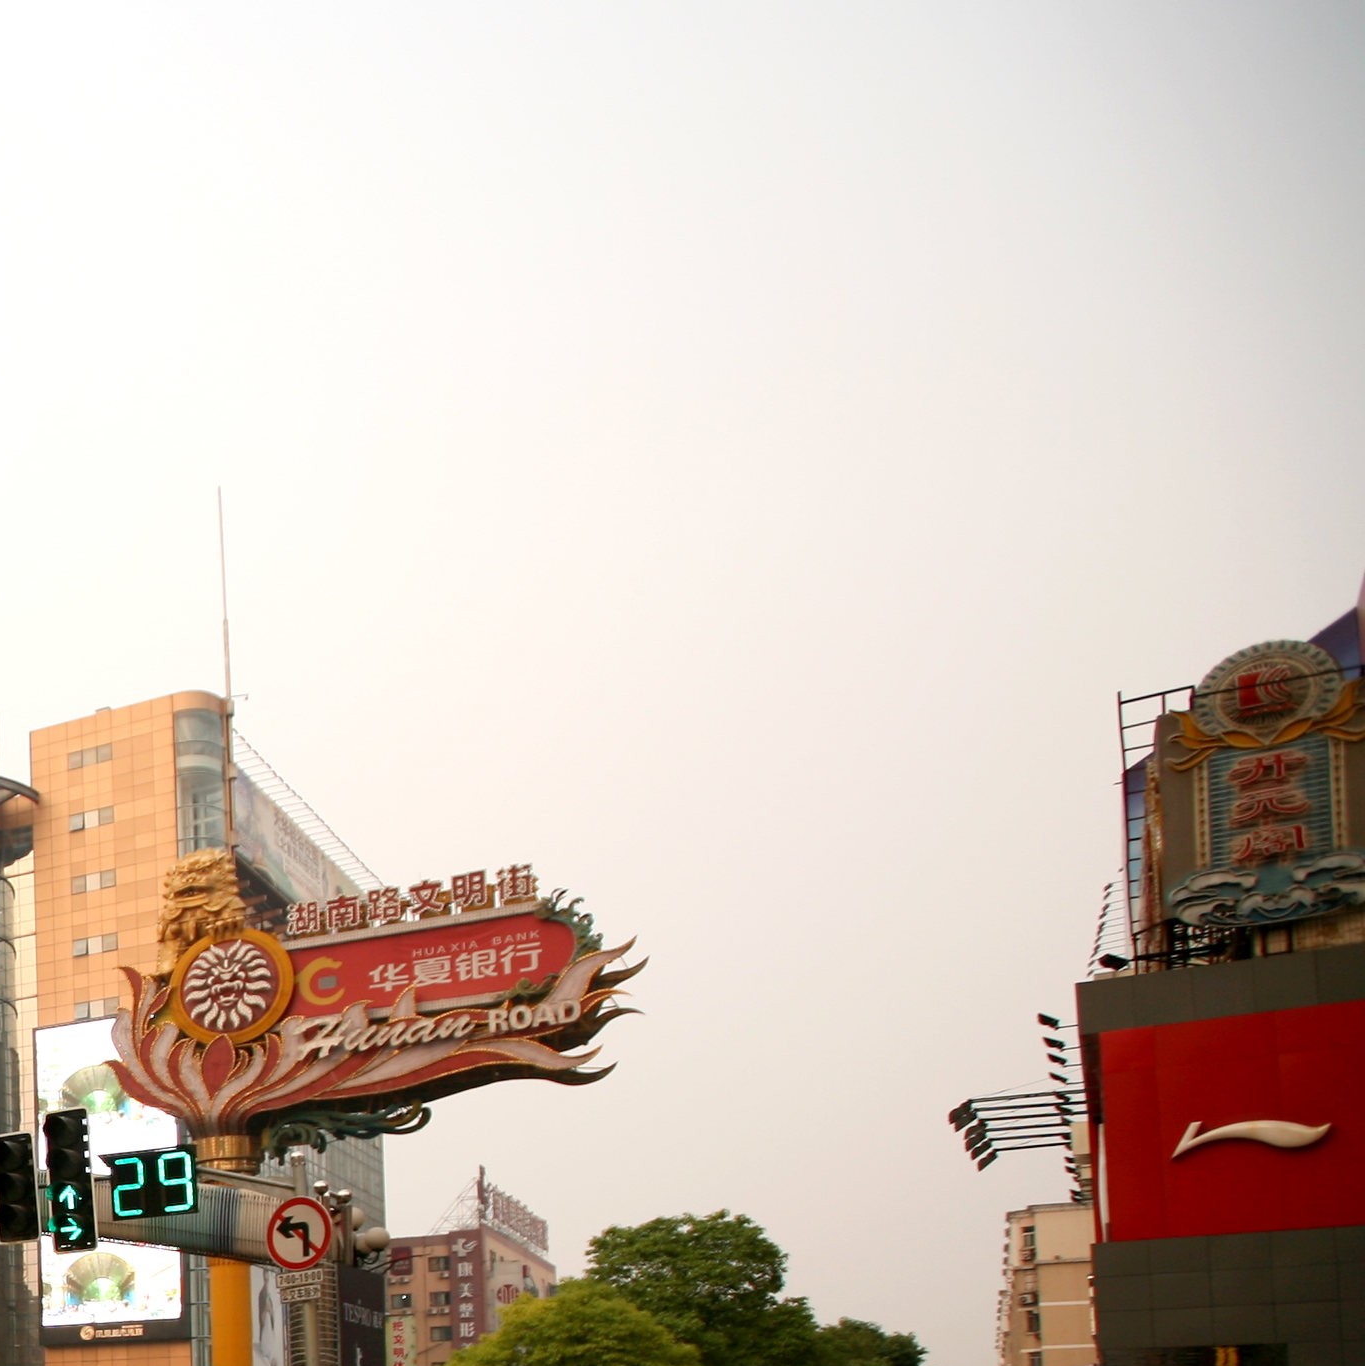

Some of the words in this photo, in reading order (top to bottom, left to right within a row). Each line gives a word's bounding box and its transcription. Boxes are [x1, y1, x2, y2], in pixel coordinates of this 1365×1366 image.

[285, 863, 540, 936] 湖南路文明街
[369, 941, 543, 992] 华夏银行
[412, 940, 479, 957] HUAXIA
[492, 929, 541, 945] BANK
[298, 1011, 476, 1062] Hunan
[487, 998, 582, 1036] ROAD
[113, 1150, 194, 1218] 29
[457, 1261, 475, 1346] 康美整形
